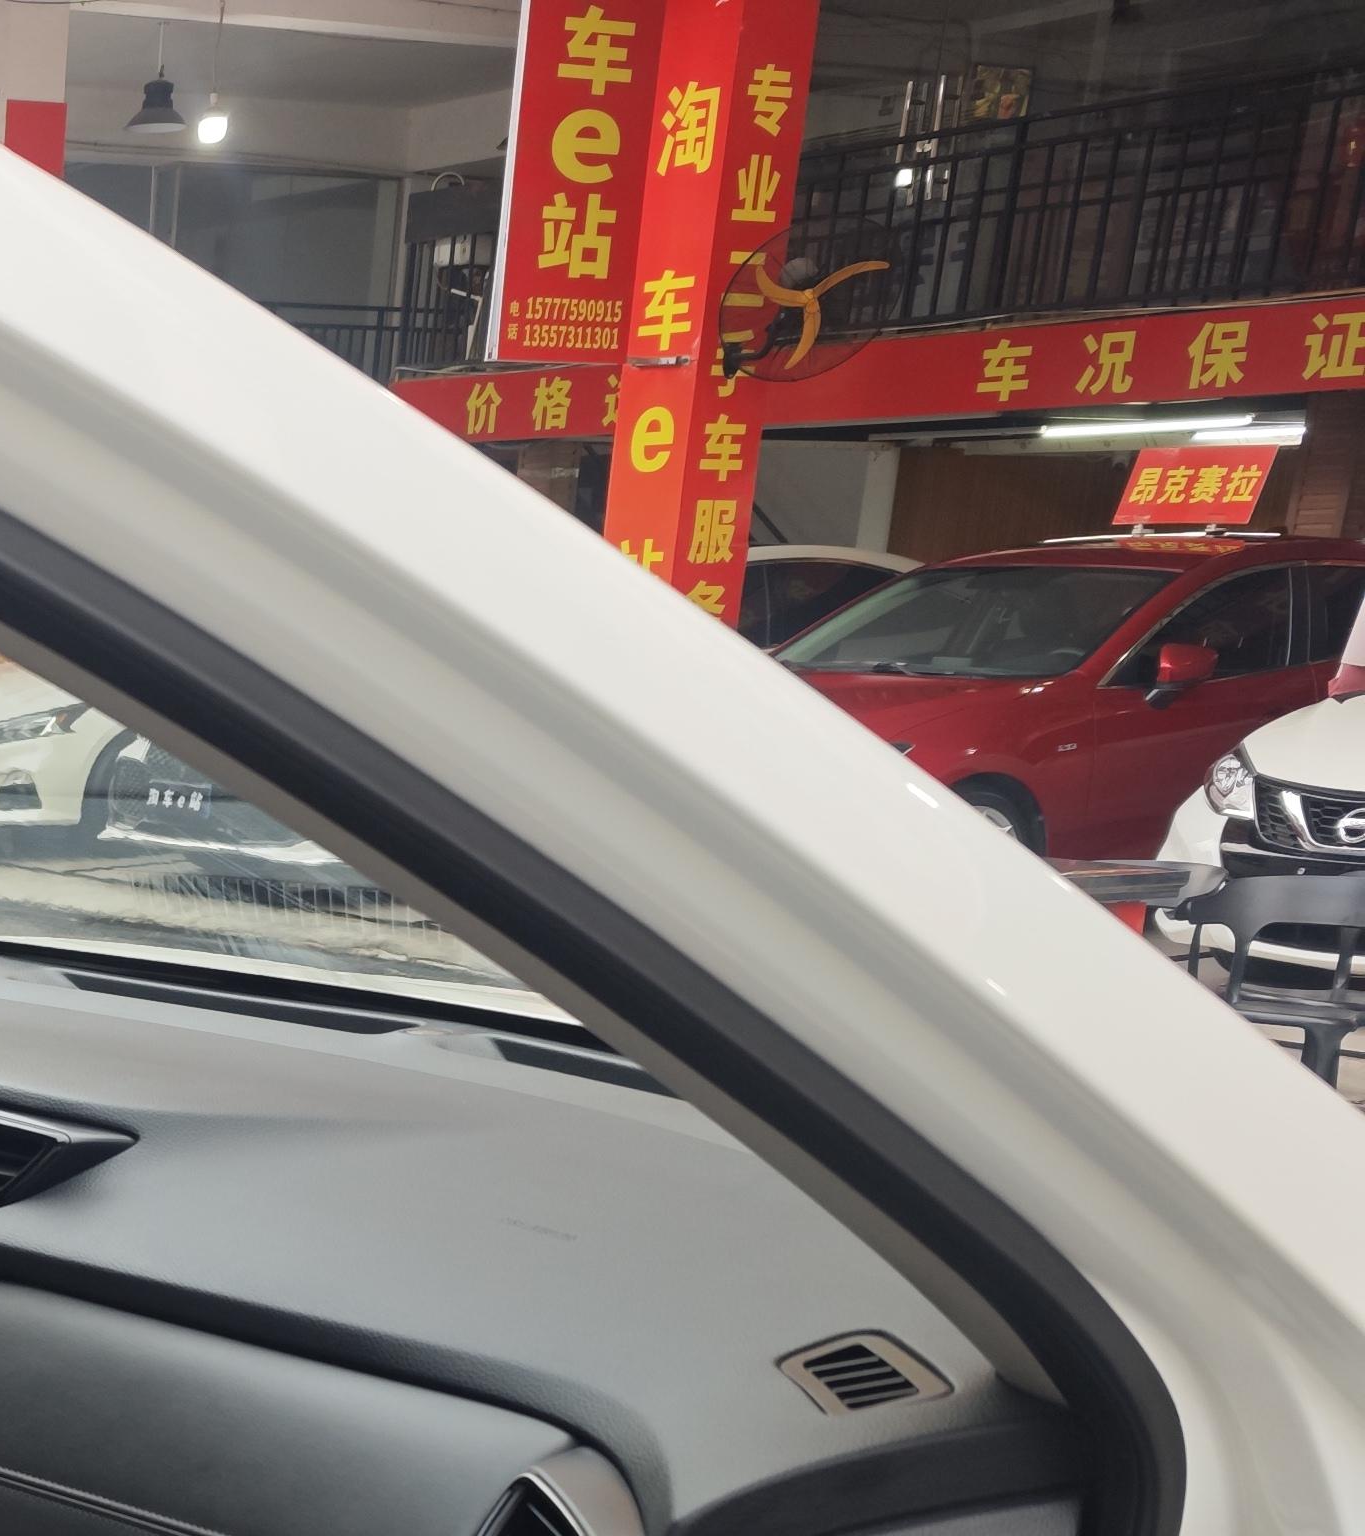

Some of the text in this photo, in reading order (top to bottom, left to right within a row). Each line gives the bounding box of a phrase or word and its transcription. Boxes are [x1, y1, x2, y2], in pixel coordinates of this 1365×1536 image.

[525, 296, 622, 323] 15777590915
[522, 323, 619, 350] 13557311301
[976, 311, 1365, 403] 车况保证
[1127, 463, 1263, 506] 昂克赛拉
